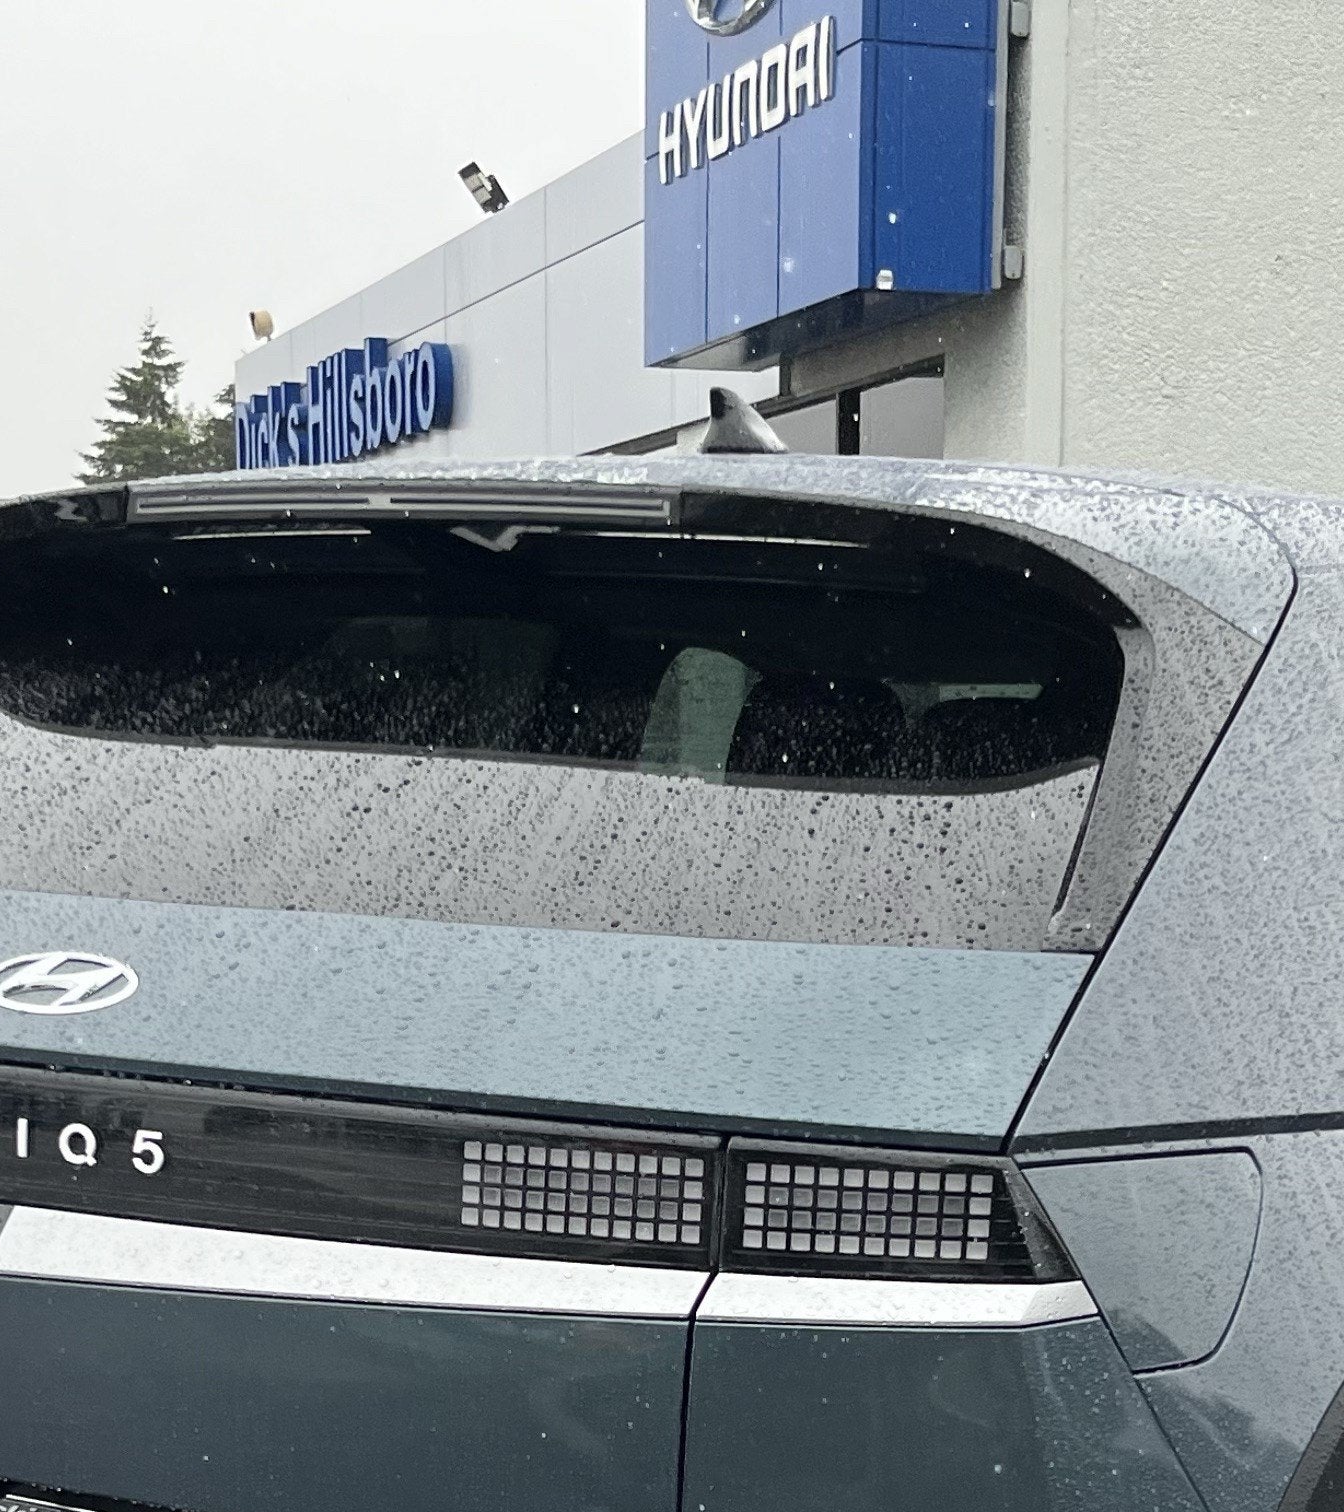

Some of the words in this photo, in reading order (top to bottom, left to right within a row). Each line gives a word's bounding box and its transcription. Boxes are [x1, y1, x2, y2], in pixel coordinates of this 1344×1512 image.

[658, 14, 837, 186] HYUNDAI
[235, 381, 301, 470] Dick's
[306, 337, 454, 467] Hillsboro
[131, 1129, 165, 1175] 5
